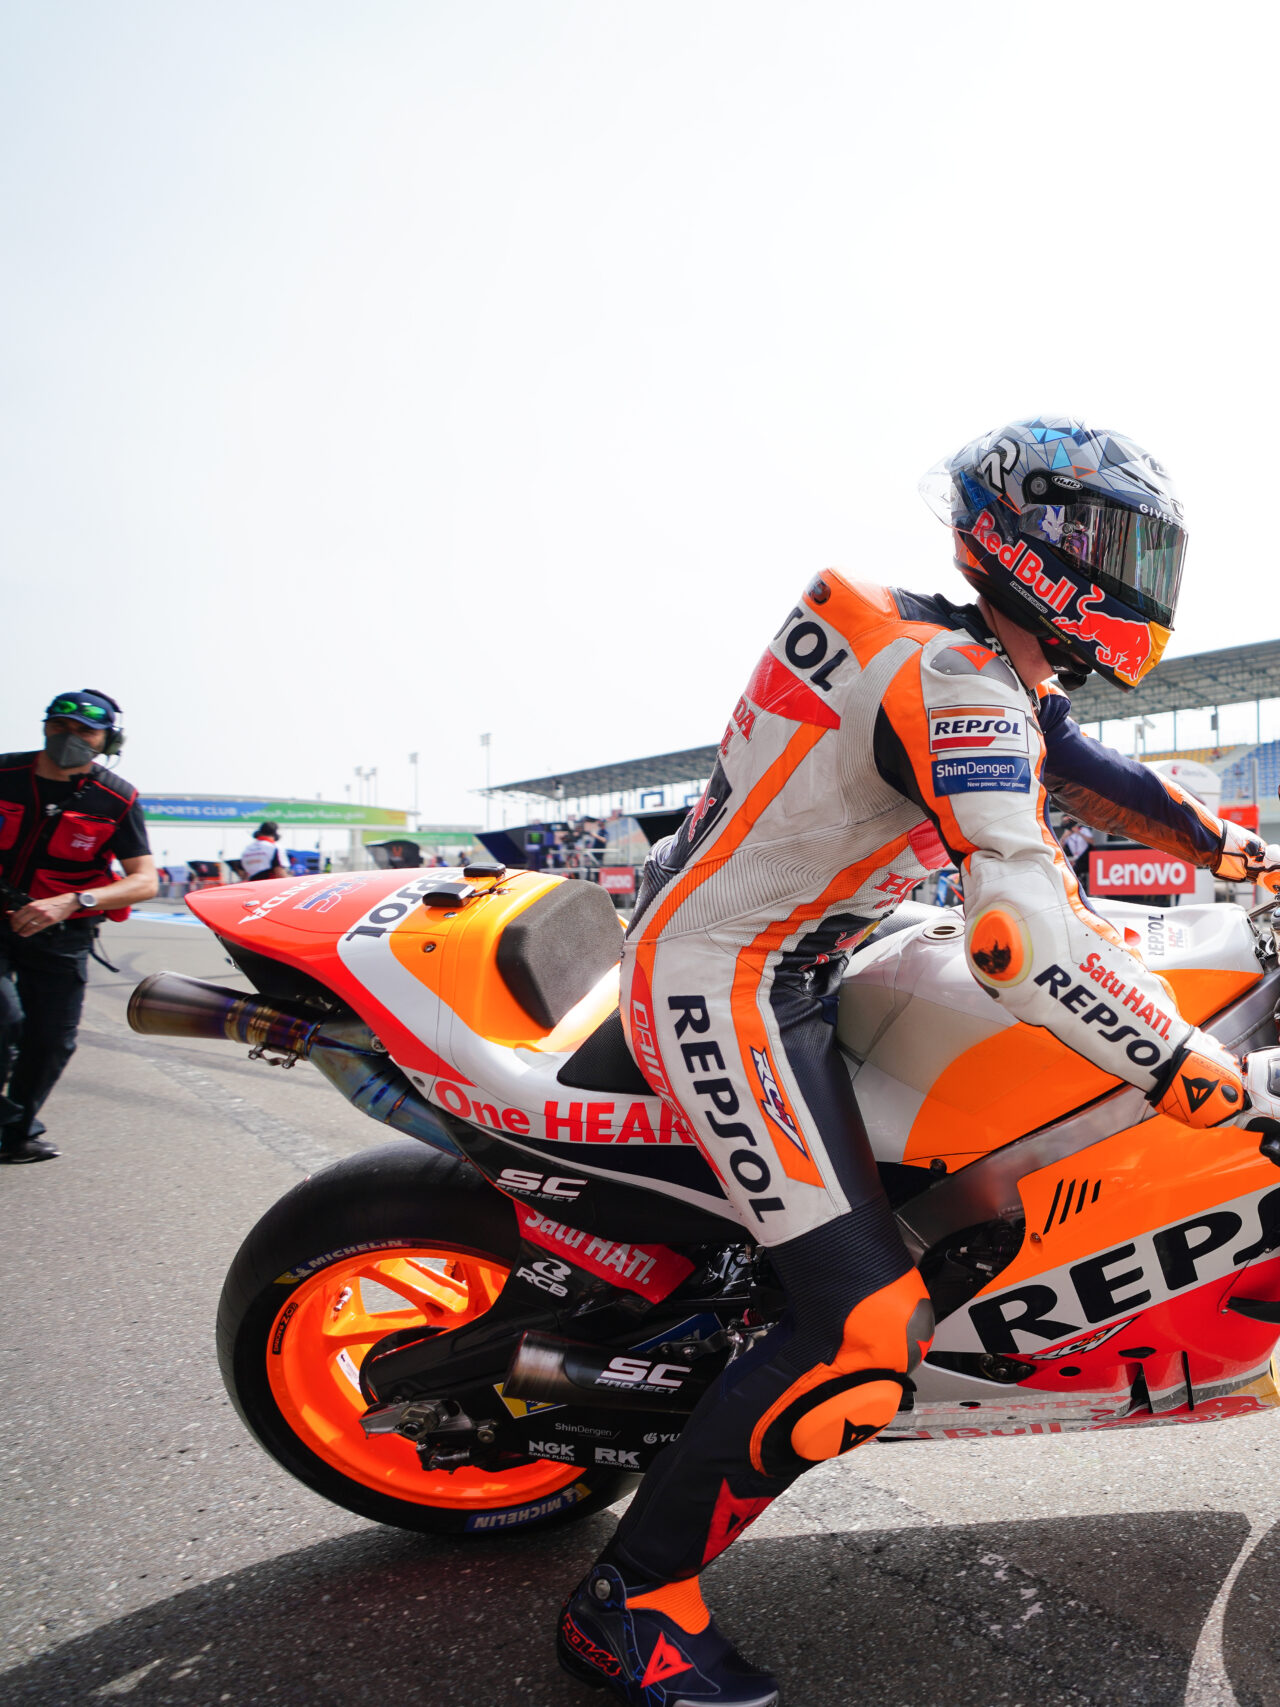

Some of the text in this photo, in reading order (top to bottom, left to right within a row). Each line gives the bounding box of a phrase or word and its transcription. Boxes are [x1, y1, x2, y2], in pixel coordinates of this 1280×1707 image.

[1054, 477, 1081, 489] HJC
[934, 719, 1021, 736] REPSOL
[936, 762, 1015, 778] ShinDengen
[151, 804, 200, 816] SPORTS
[203, 805, 238, 817] CLUB
[1097, 858, 1187, 886] Lenovo
[1079, 953, 1126, 997] Satu
[434, 1080, 696, 1144] One HEAR
[667, 995, 786, 1223] REPSOL
[497, 1168, 588, 1197] SC
[308, 1240, 402, 1268] MICHELIN
[516, 1267, 568, 1297] RCB
[600, 1356, 692, 1387] SC
[594, 1378, 678, 1394] PROJECT
[555, 1423, 612, 1436] ShinDengen
[947, 1422, 1062, 1439] Bull
[529, 1440, 574, 1456] NGK
[595, 1447, 640, 1464] RK
[474, 1498, 562, 1528] MICHELIN
